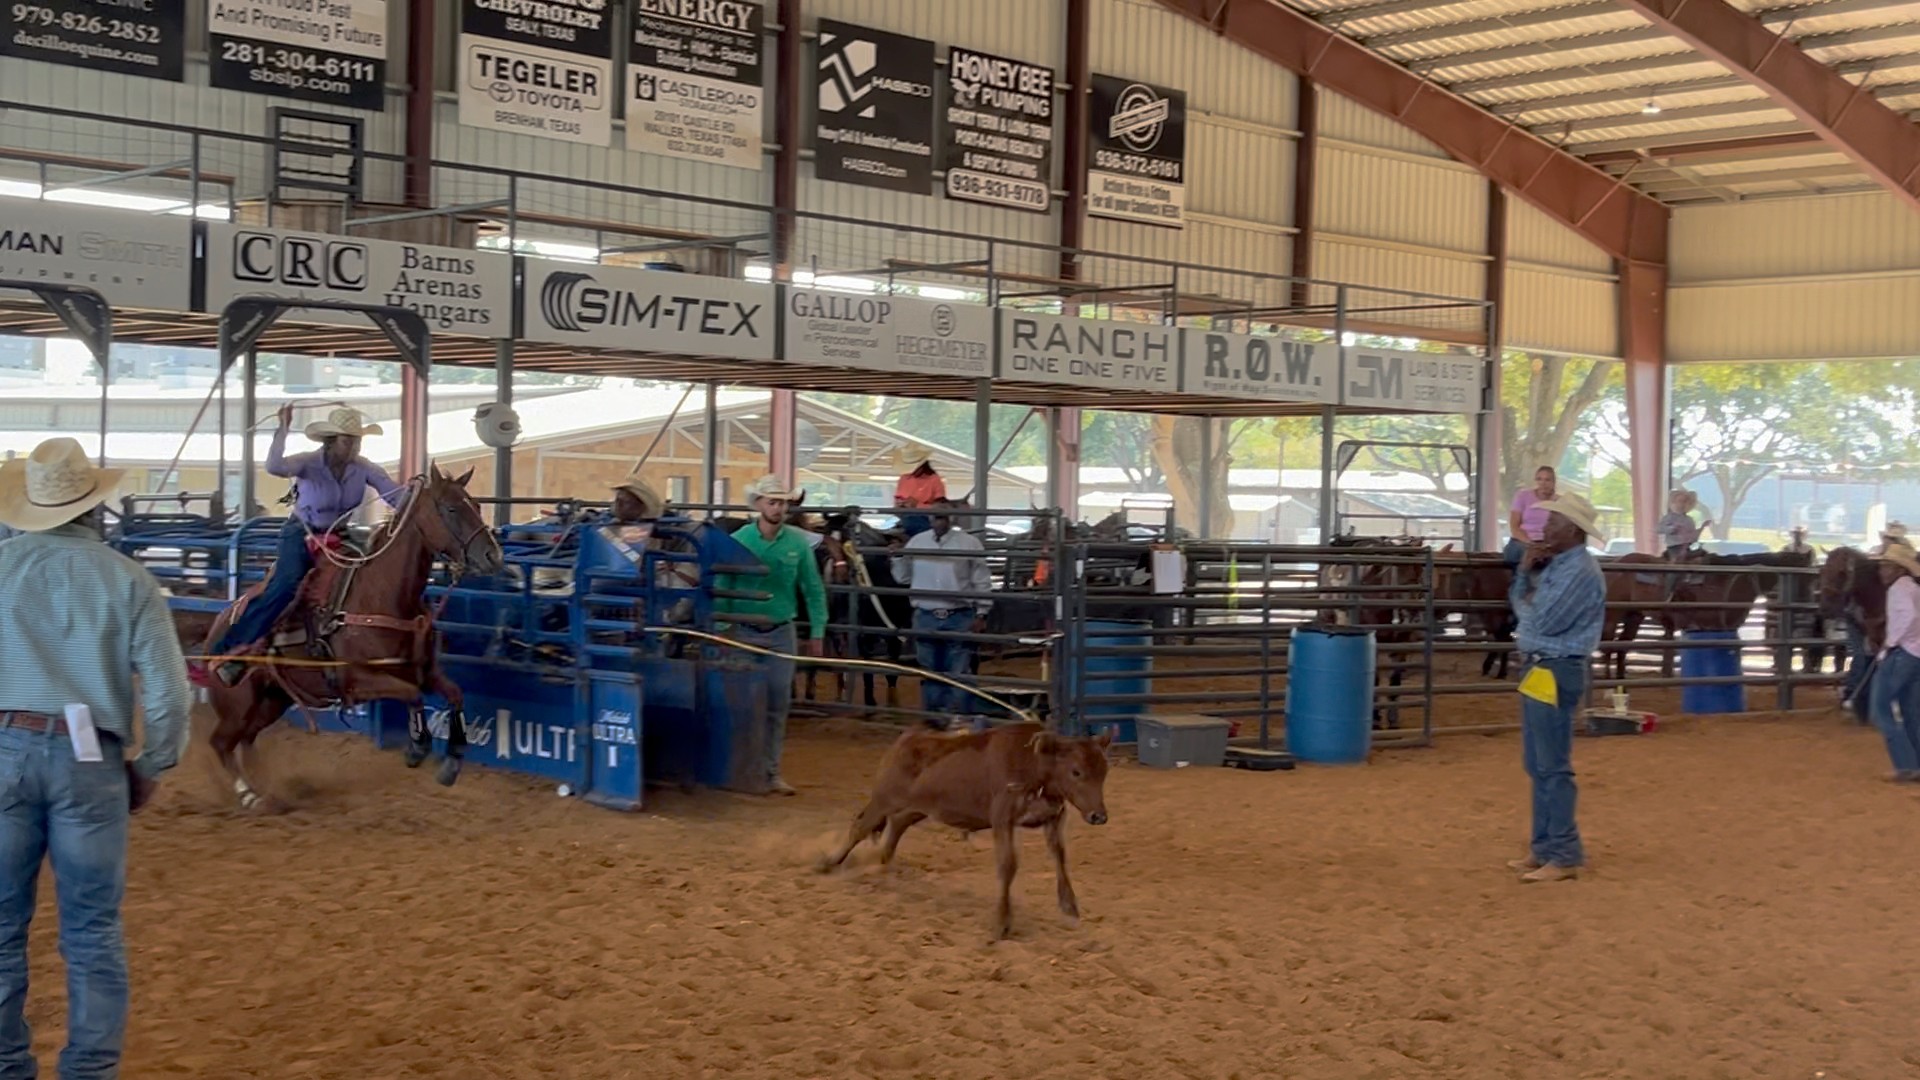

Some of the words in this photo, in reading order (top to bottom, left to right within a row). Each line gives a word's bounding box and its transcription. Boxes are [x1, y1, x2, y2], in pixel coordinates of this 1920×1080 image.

[12, 4, 161, 43] 979-826-2852
[317, 0, 351, 19] Past
[475, 0, 602, 30] CHEVROLET
[639, 0, 755, 30] ENERGY
[214, 4, 247, 25] And
[252, 8, 331, 42] Promising
[335, 22, 383, 47] Future
[542, 23, 577, 42] TEXAS
[13, 29, 160, 66] decilloequine.com
[222, 41, 375, 82] 281-304-6111
[250, 68, 351, 95] sbslp.com
[476, 53, 598, 97] TEGELER
[871, 76, 933, 98] HASSCO
[951, 51, 1019, 90] HONEY
[1018, 65, 1052, 97] BEE
[516, 88, 583, 113] TOYOTA
[658, 78, 758, 110] CASTLEROAD
[981, 86, 1051, 118] PUMPING
[549, 118, 581, 135] TEXAS
[682, 114, 720, 131] CASTLE
[688, 129, 720, 144] TEXAS
[241, 236, 364, 285] CRC
[402, 245, 475, 275] Barns
[390, 271, 482, 300] Arenas
[384, 293, 491, 329] Hangars
[577, 287, 762, 338] SIM-TEX
[791, 292, 891, 325] GALLOP
[814, 332, 879, 349] Petrochemical
[822, 344, 862, 359] Services
[896, 335, 988, 361] HEGEMEYER
[1013, 318, 1168, 363] RANCH
[1013, 355, 1059, 373] ONE
[1069, 359, 1113, 378] ONE
[1122, 364, 1167, 382] FIVE
[1350, 354, 1403, 400] JM
[1408, 359, 1438, 378] LAND
[1451, 363, 1474, 381] SITE
[1414, 384, 1466, 403] SERVICES
[592, 723, 638, 745] ULTRA
